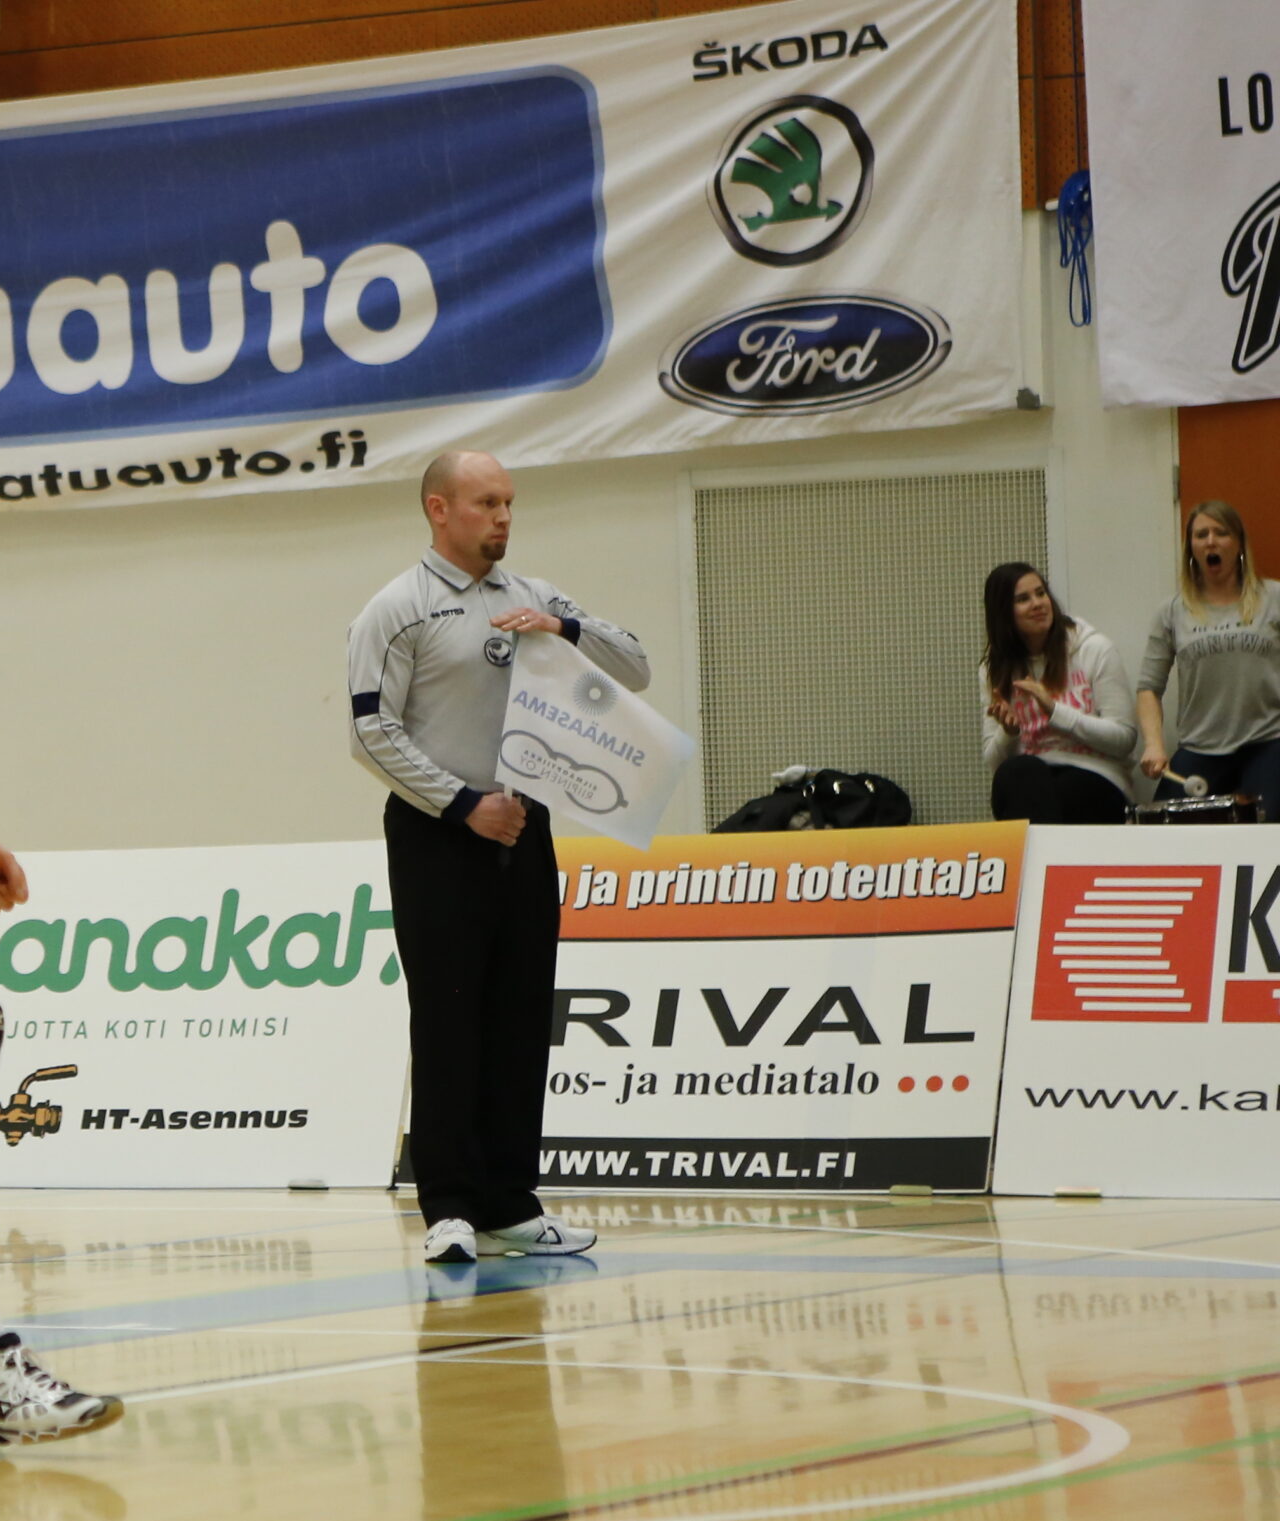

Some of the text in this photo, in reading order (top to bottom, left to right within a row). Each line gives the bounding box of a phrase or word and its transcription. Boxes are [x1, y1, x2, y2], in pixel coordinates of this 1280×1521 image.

[692, 23, 889, 82] ŠKODA
[725, 314, 882, 394] Ford
[573, 863, 619, 910] ja
[626, 861, 777, 910] printin
[785, 851, 1007, 902] toteuttaja
[7, 1017, 290, 1040] JOTTA KOTI TOIMISI
[616, 1063, 658, 1105] ja
[674, 1062, 881, 1097] mediatalo
[81, 1107, 309, 1131] HT-Asennus
